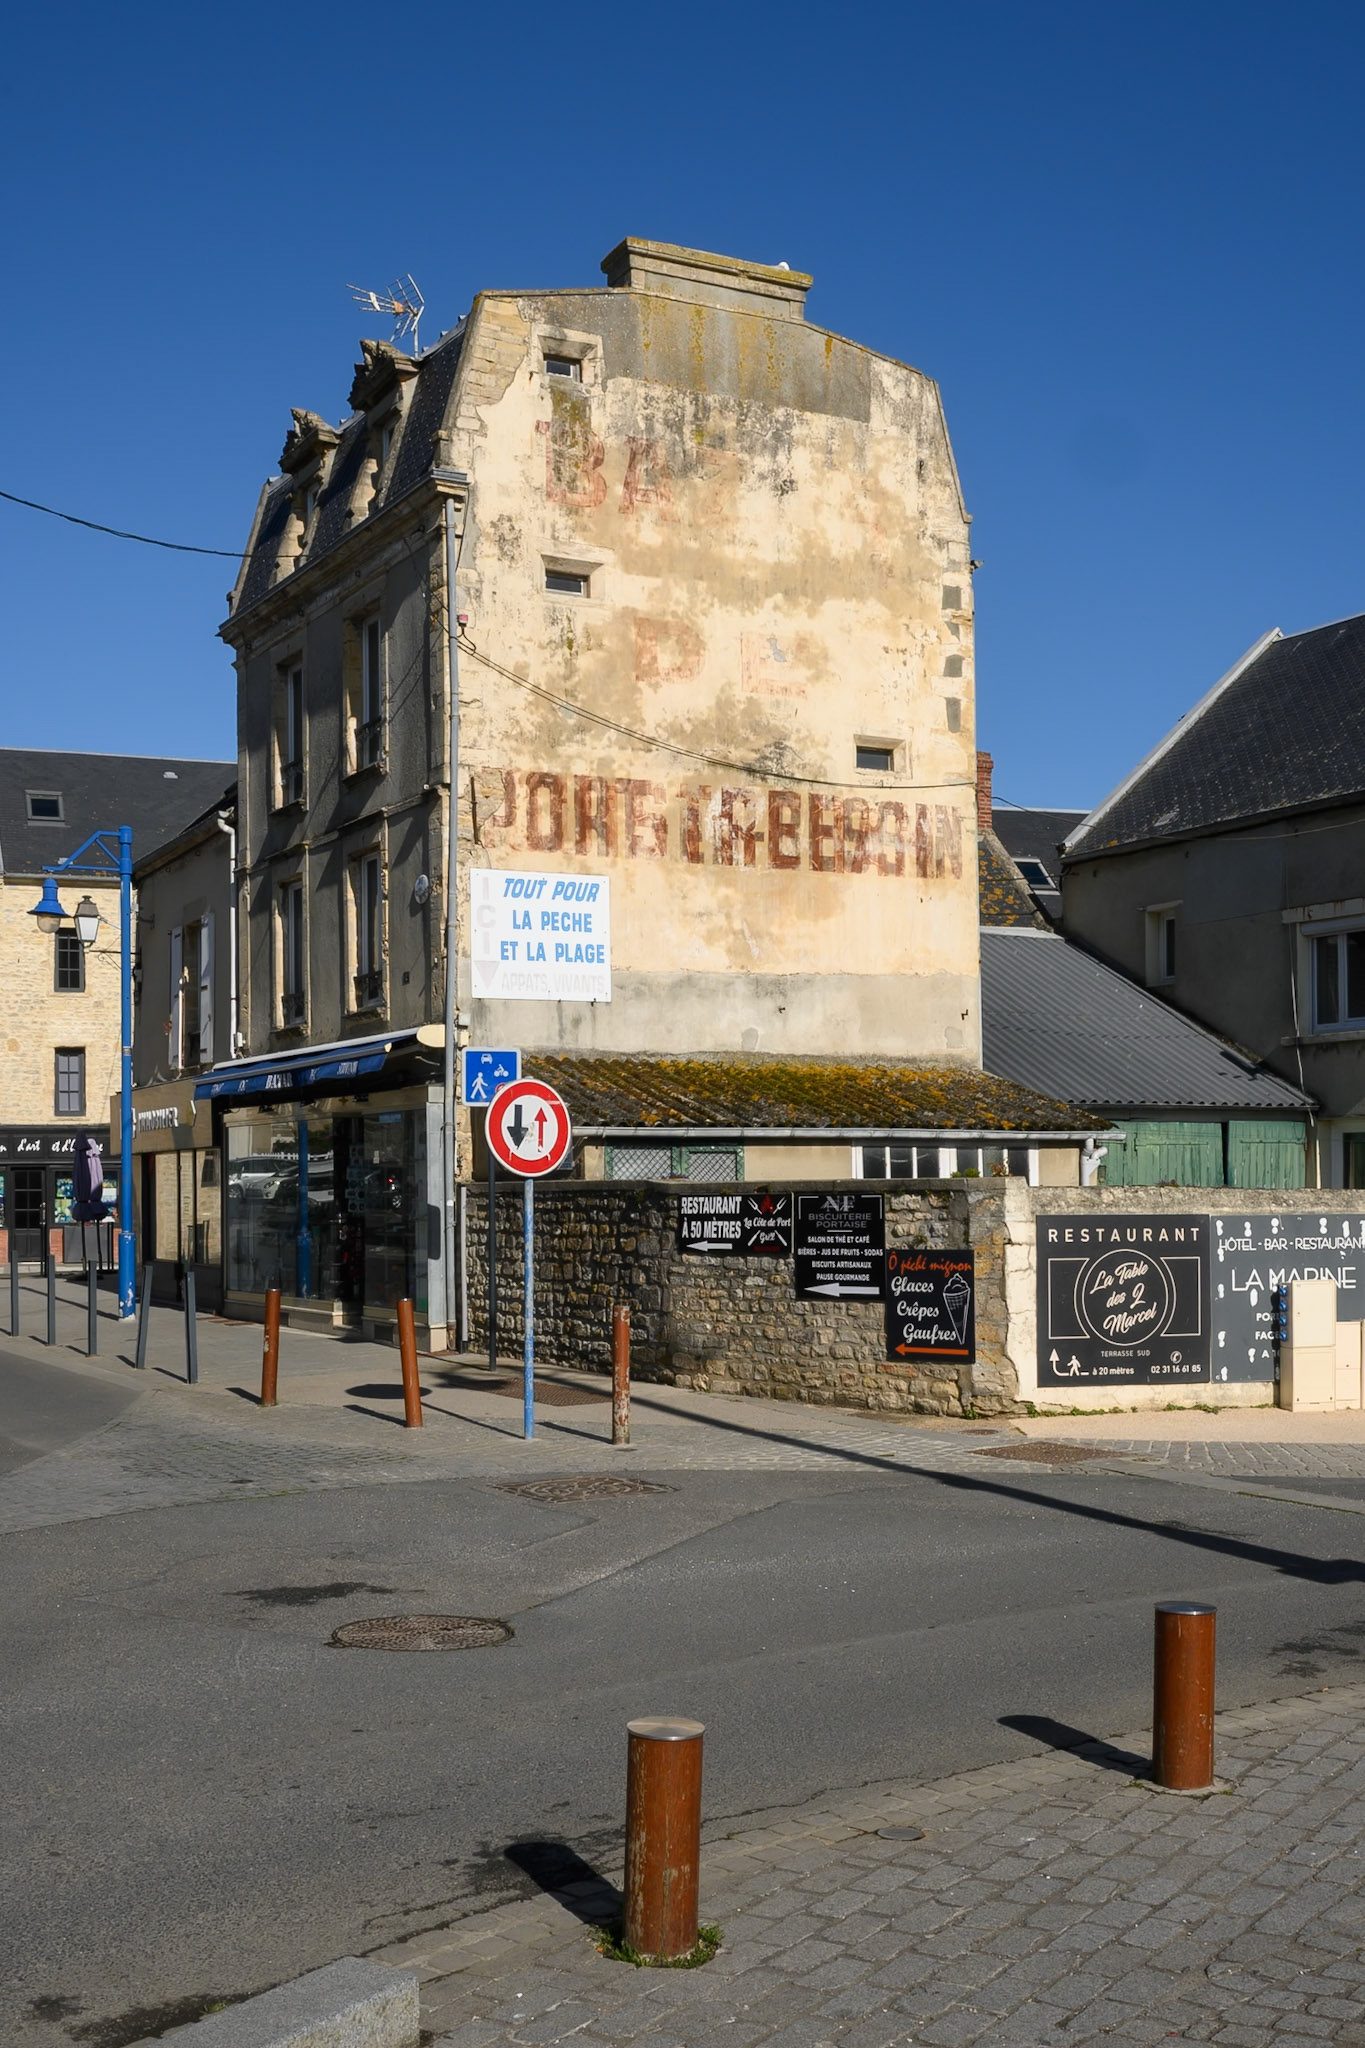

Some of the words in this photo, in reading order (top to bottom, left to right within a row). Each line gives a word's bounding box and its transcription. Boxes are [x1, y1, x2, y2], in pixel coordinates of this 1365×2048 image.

[503, 878, 548, 899] TOUT
[551, 881, 601, 903] POUR
[512, 909, 532, 930] LA
[540, 911, 592, 933] PECHE
[500, 940, 519, 961] ET
[526, 942, 546, 962] LA
[555, 943, 605, 964] PLAGE
[501, 972, 548, 992] APPATS
[554, 973, 605, 994] VIVANTS
[17, 1138, 40, 1152] d'art
[52, 1141, 60, 1152] et
[681, 1196, 742, 1214] RESTAURANT
[743, 1217, 752, 1229] La
[767, 1218, 776, 1227] de
[776, 1217, 791, 1227] Port
[808, 1213, 872, 1221] BISCUITERIE
[816, 1221, 867, 1229] PORTAISE
[682, 1216, 689, 1239] À
[690, 1221, 702, 1239] 50
[703, 1216, 742, 1239] MÈTRES
[1048, 1228, 1200, 1243] RESTAURANT
[835, 1234, 846, 1243] THÉ
[855, 1234, 870, 1243] CAFÉ
[1218, 1236, 1257, 1251] HÔTEL
[1264, 1237, 1288, 1251] BAR
[798, 1246, 816, 1256] BIÈRES
[820, 1248, 831, 1256] JUS
[832, 1248, 839, 1256] DE
[840, 1248, 860, 1256] FRUITS
[864, 1248, 883, 1256] SODAS
[812, 1260, 836, 1268] BISCUITS
[836, 1261, 872, 1269] ARTISANAUX
[929, 1258, 972, 1278] mignon
[834, 1273, 870, 1282] GOURMANDE
[1090, 1270, 1114, 1294] La
[1114, 1260, 1149, 1285] Table
[1231, 1268, 1265, 1292] LA
[891, 1276, 934, 1297] Glaces
[1106, 1291, 1127, 1308] des
[896, 1300, 939, 1321] Crêpes
[1103, 1302, 1157, 1337] Marcel
[903, 1323, 957, 1344] Gaufres
[1101, 1350, 1134, 1358] TERRASSE
[1098, 1367, 1108, 1375] 20
[1109, 1367, 1135, 1375] mètres
[1172, 1365, 1180, 1373] 16
[1182, 1365, 1190, 1373] 61
[1191, 1365, 1201, 1373] 85
